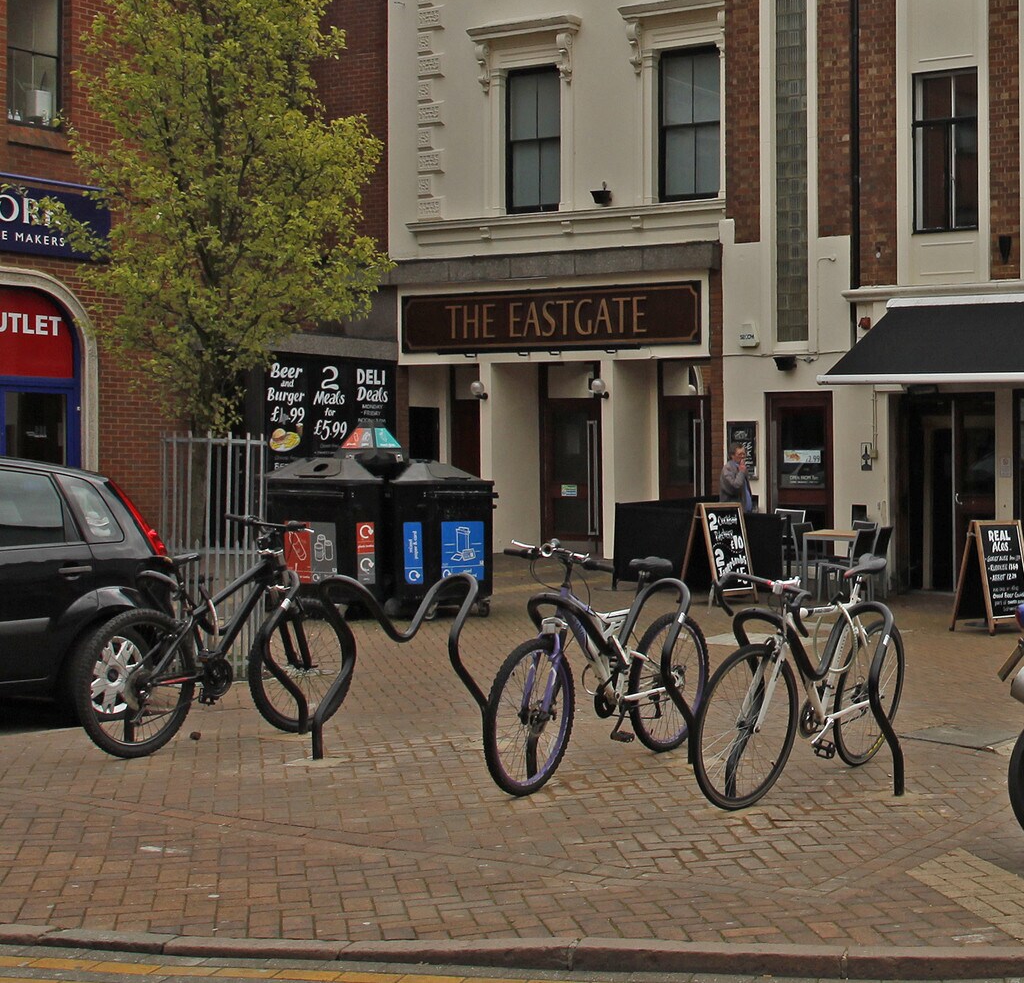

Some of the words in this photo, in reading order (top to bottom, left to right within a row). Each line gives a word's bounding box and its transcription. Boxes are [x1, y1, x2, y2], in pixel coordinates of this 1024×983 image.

[15, 231, 65, 247] MAKERS
[445, 304, 496, 340] THE
[509, 296, 647, 338] EASTGATE
[270, 362, 303, 379] Beer
[321, 366, 339, 391] 2
[356, 368, 386, 386] DELI
[280, 379, 294, 388] and
[267, 387, 305, 406] Burger
[313, 390, 345, 406] Meals
[356, 386, 389, 403] Deals
[324, 407, 336, 417] for
[313, 419, 348, 441] £5.99
[708, 512, 719, 532] 2
[988, 529, 1011, 542] REAL
[714, 548, 725, 568] 2
